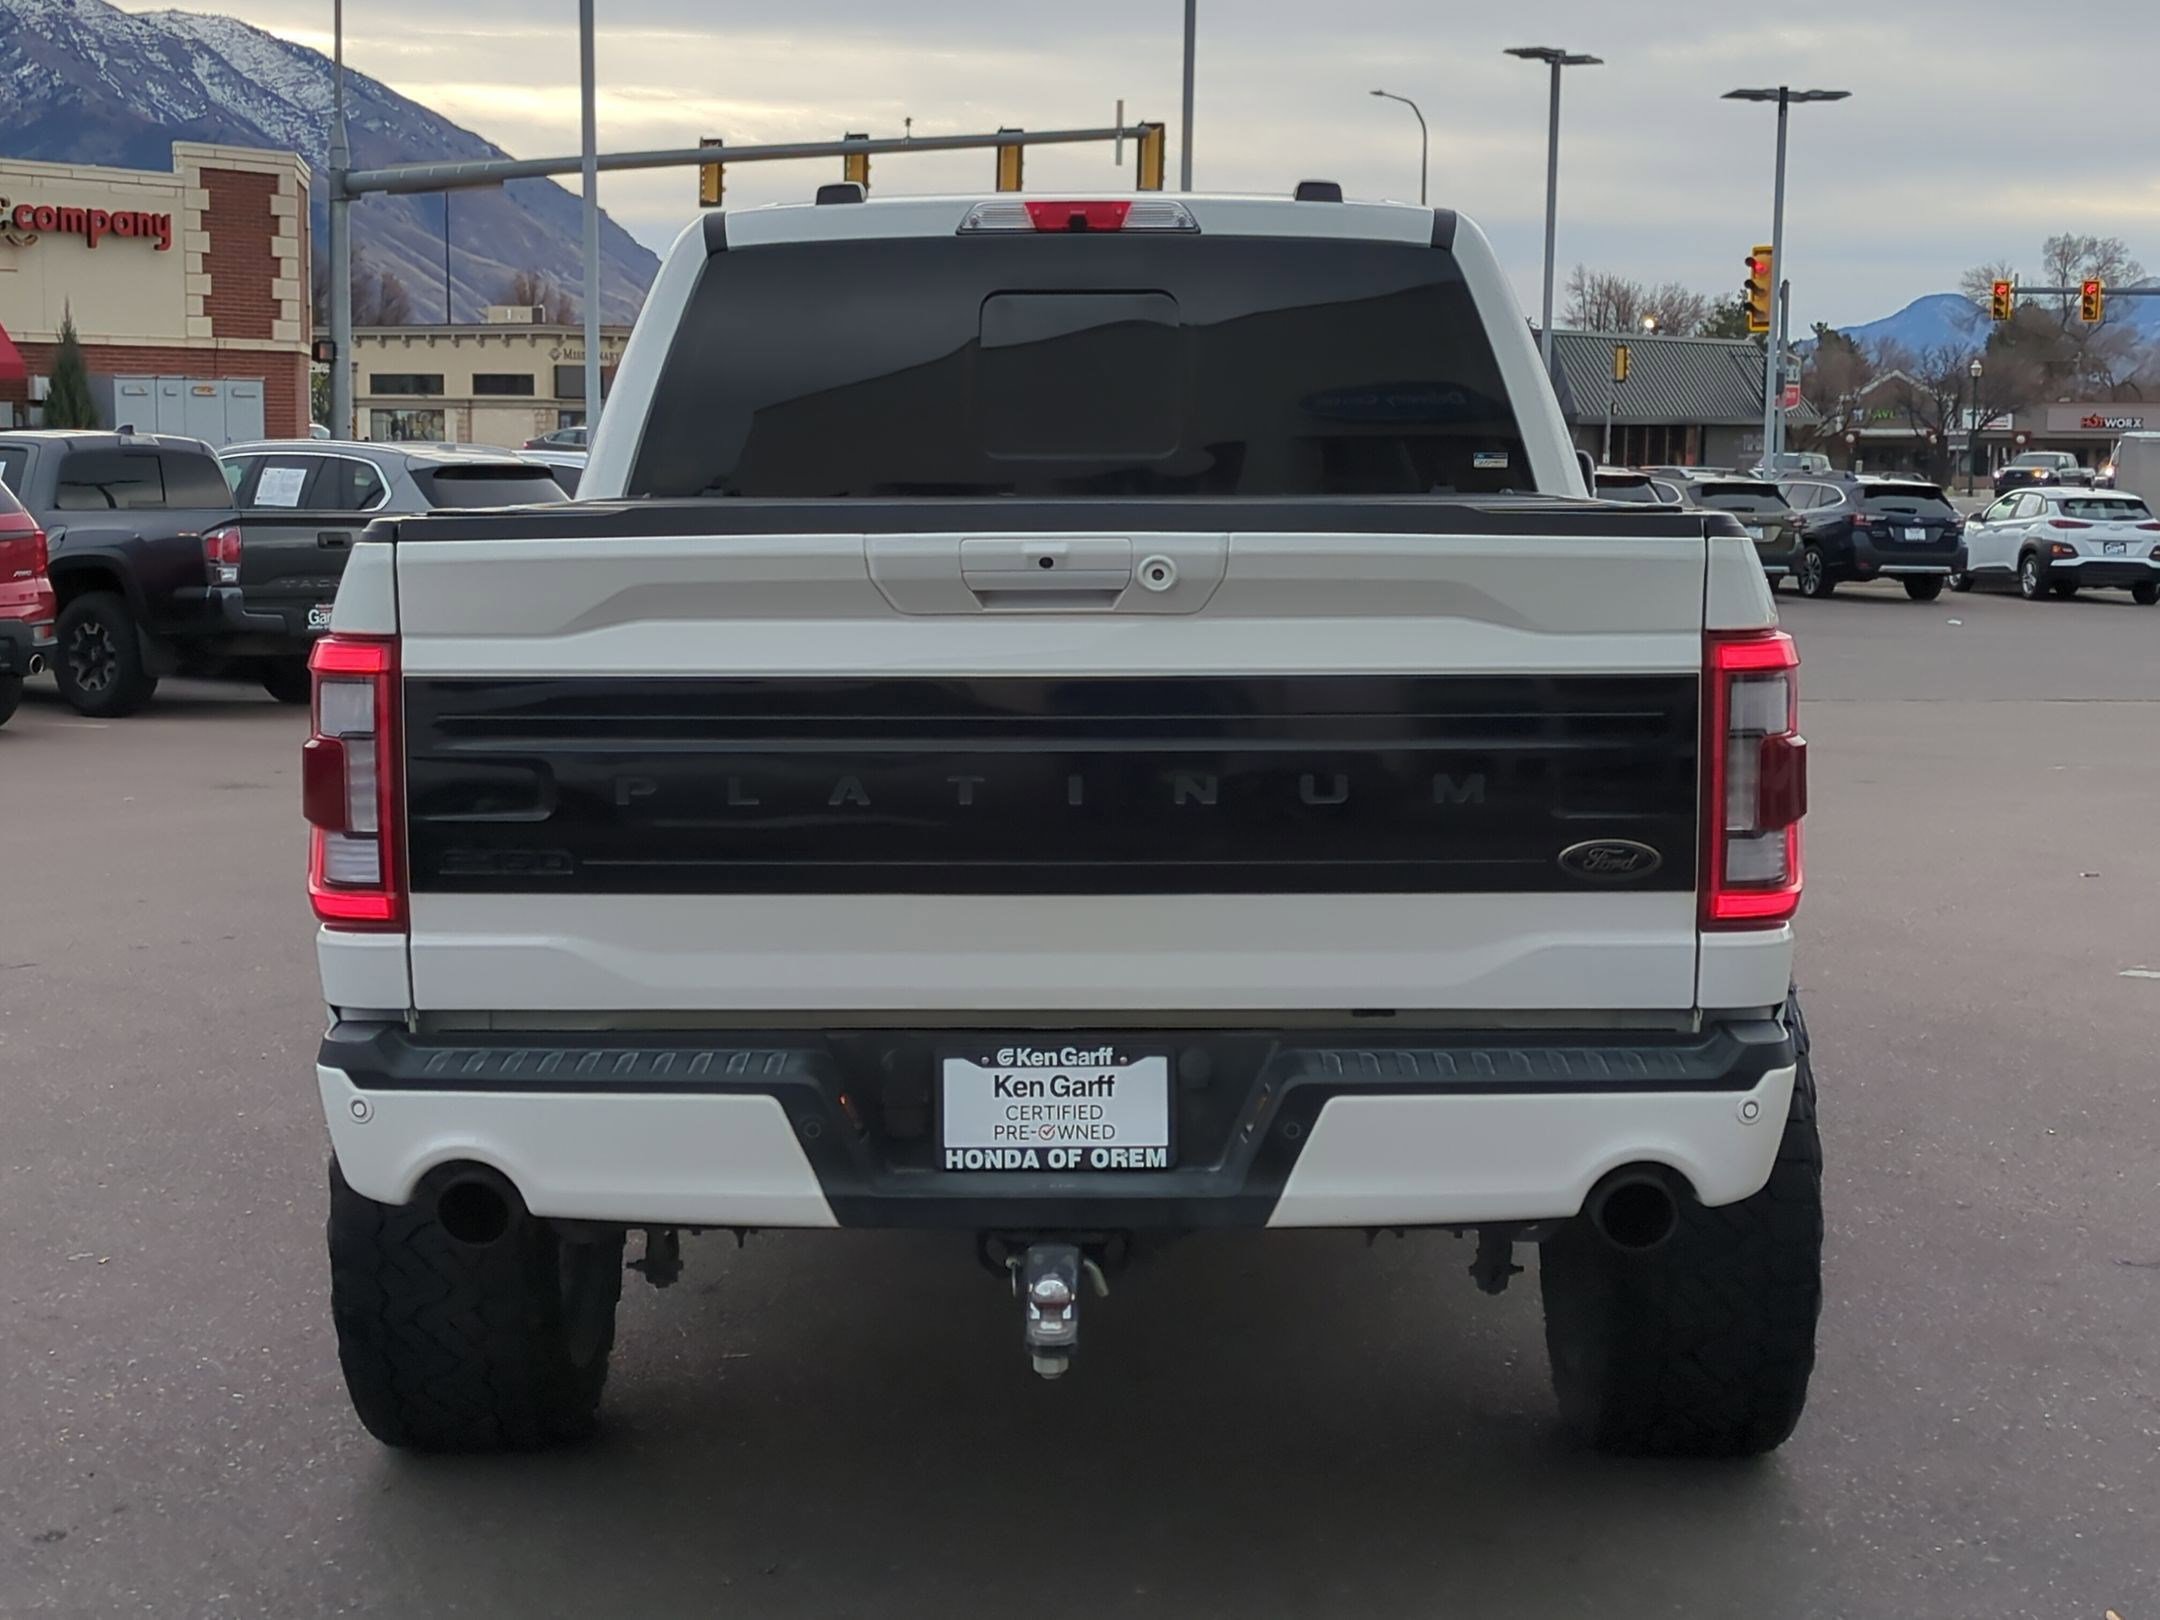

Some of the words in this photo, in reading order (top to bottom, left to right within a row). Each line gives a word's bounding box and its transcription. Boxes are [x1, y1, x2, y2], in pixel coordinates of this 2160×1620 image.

[12, 204, 172, 251] company
[614, 773, 1486, 806] PLATINUM
[1583, 847, 1639, 871] Ford
[1016, 1047, 1058, 1067] Ken
[1060, 1047, 1114, 1067] Garff
[993, 1075, 1045, 1098] Ken
[1050, 1074, 1115, 1098] Garff
[1005, 1104, 1103, 1121] CERTIFIED
[945, 1148, 1040, 1170] HONDA
[1047, 1148, 1082, 1169] OF
[1090, 1147, 1167, 1169] OREM
